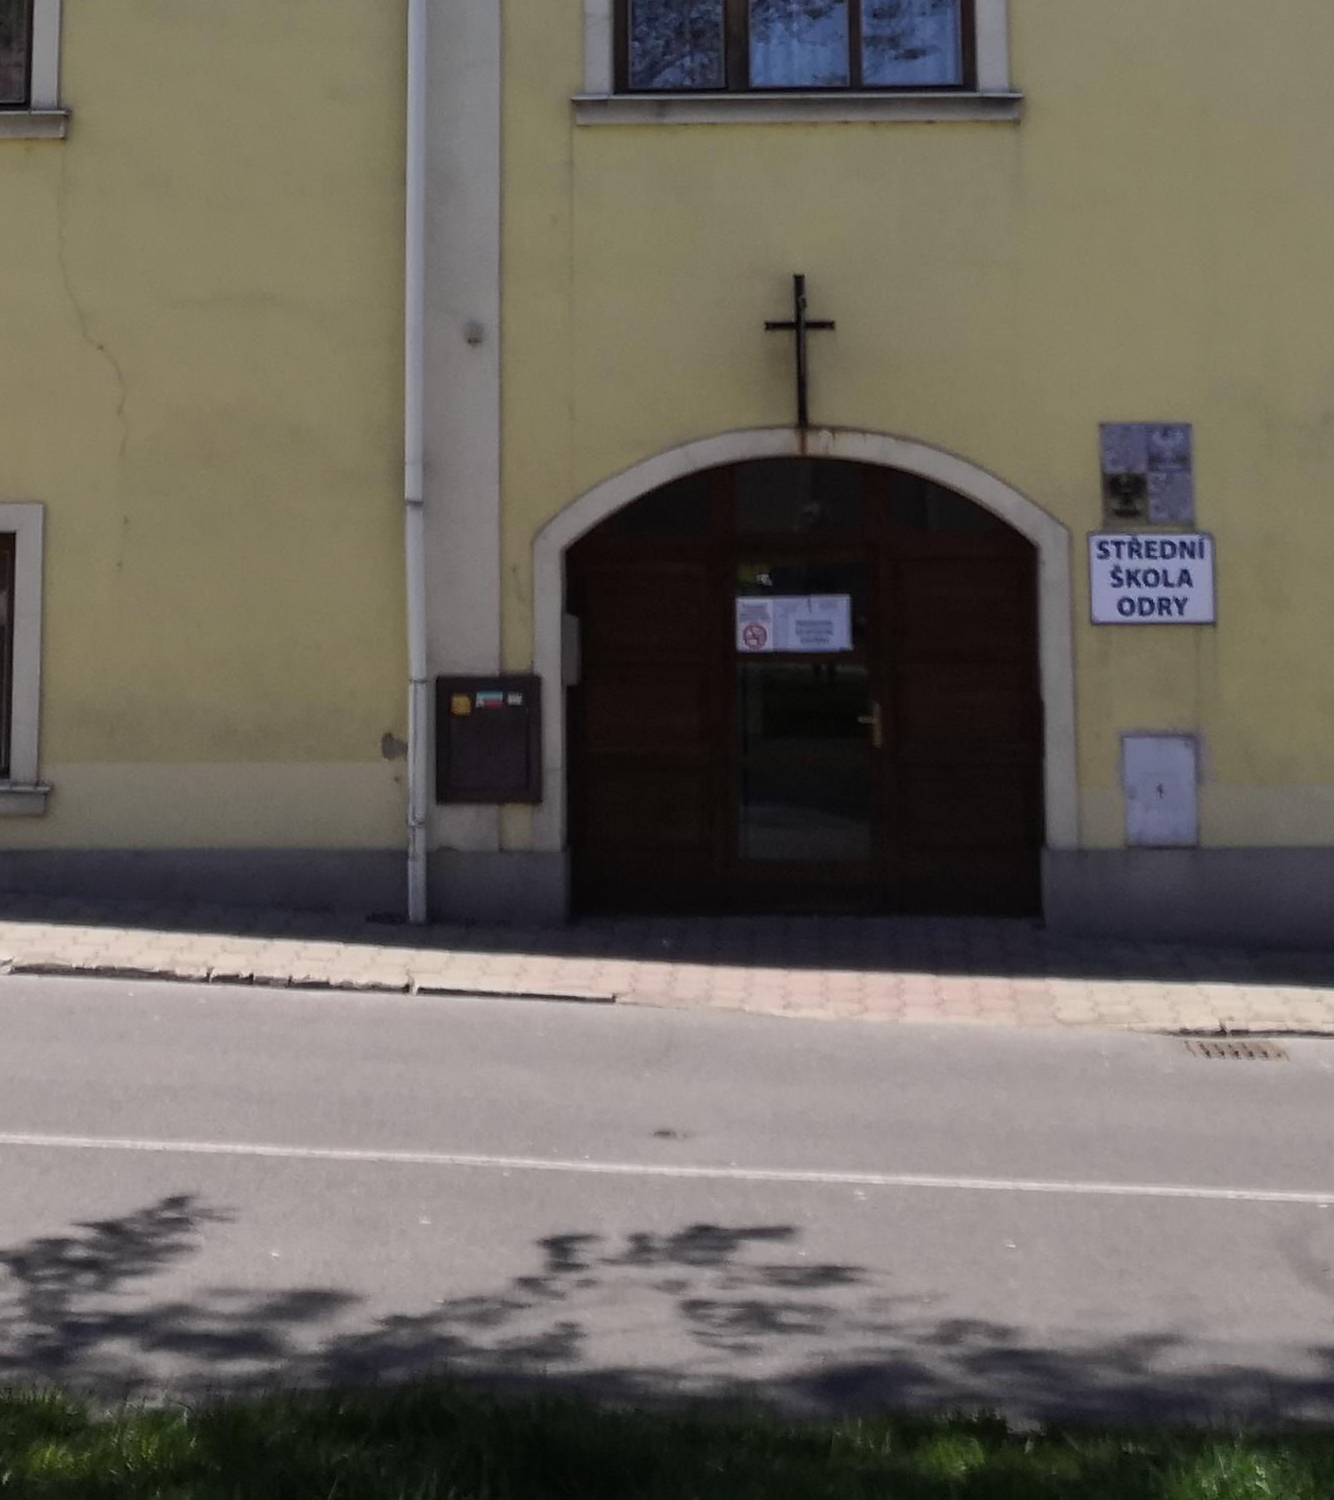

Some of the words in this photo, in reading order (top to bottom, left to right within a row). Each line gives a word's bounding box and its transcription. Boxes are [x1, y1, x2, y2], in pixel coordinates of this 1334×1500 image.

[1096, 536, 1206, 560] STŘEDNÍ
[1110, 564, 1194, 589] ŠKOLA
[1117, 596, 1189, 617] ODRY
